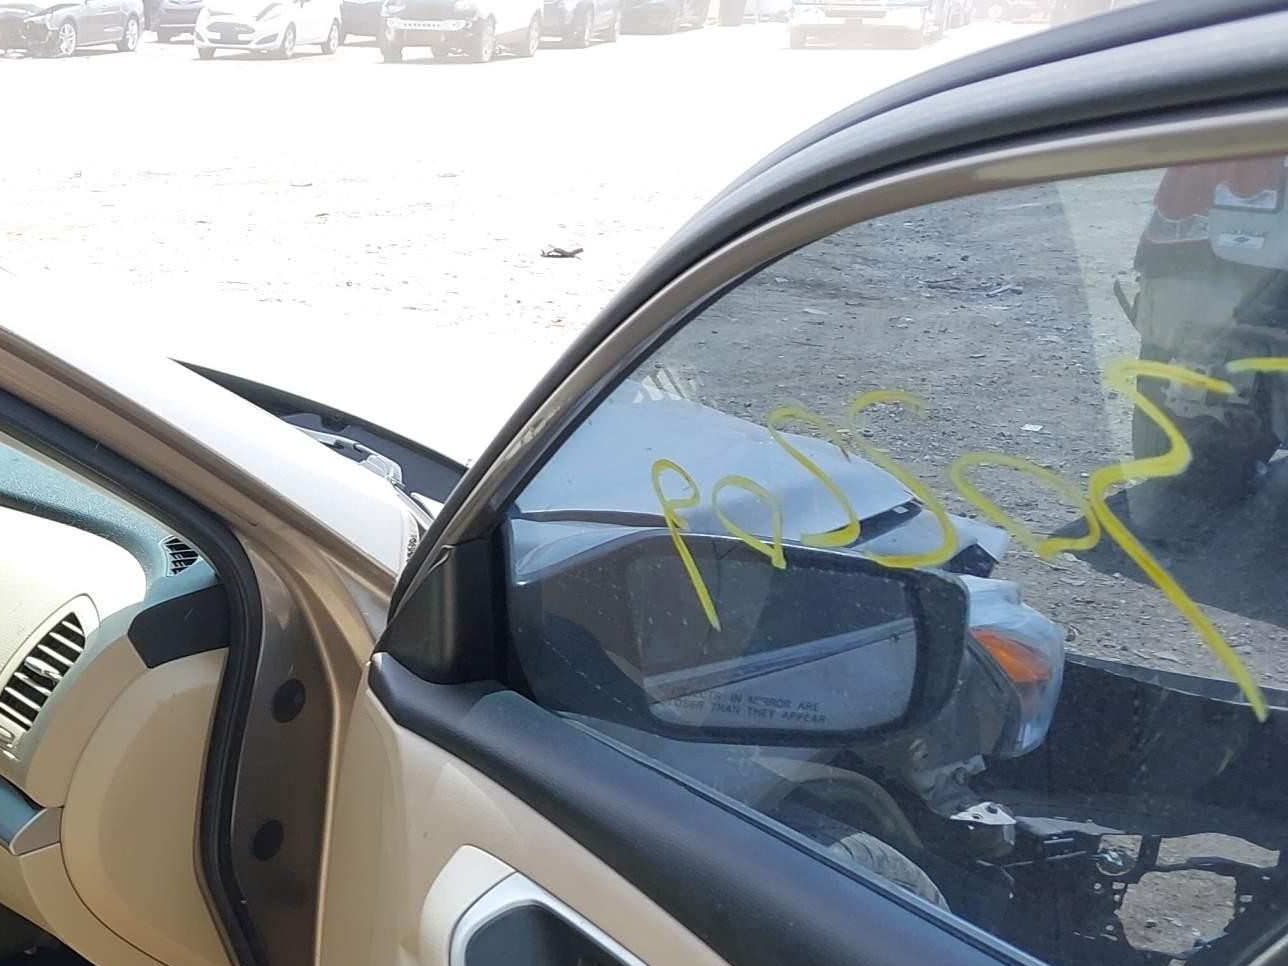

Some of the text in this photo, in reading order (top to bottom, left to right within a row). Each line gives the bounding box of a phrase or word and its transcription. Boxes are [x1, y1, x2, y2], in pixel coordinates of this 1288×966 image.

[730, 693, 743, 704] IN
[749, 695, 792, 709] MIRROR
[798, 701, 820, 712] ARE
[711, 703, 740, 715] THAN
[747, 706, 776, 719] THEY
[781, 711, 827, 723] APPEAR
